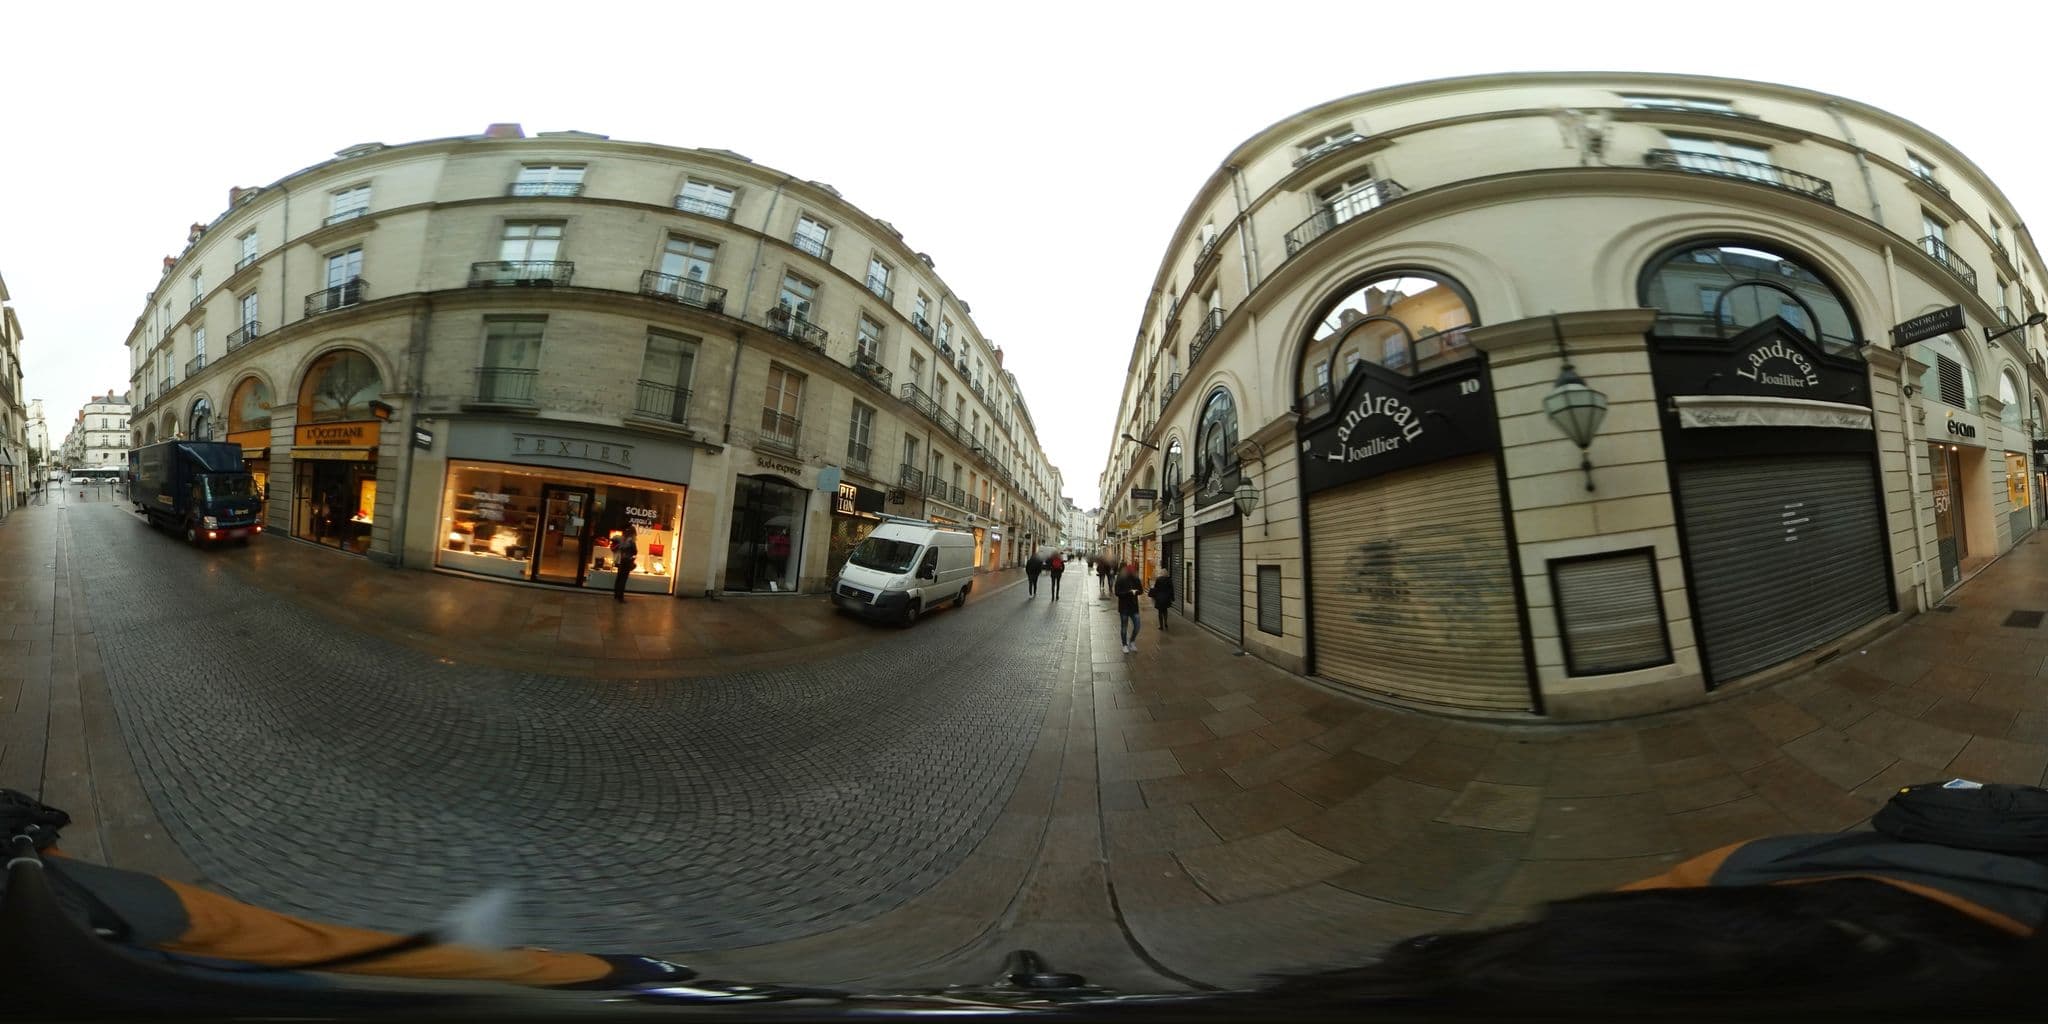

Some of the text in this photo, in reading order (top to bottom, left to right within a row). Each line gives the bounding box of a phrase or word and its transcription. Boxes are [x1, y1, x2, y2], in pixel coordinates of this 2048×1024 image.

[1737, 340, 1819, 387] Landreau
[1459, 378, 1481, 395] 10
[1761, 372, 1805, 388] Joaillier
[1328, 392, 1424, 463] Landreau
[1947, 419, 1976, 438] eram
[513, 437, 632, 462] TEXIER
[1348, 435, 1400, 463] Joaillier
[625, 506, 657, 518] SOLDES
